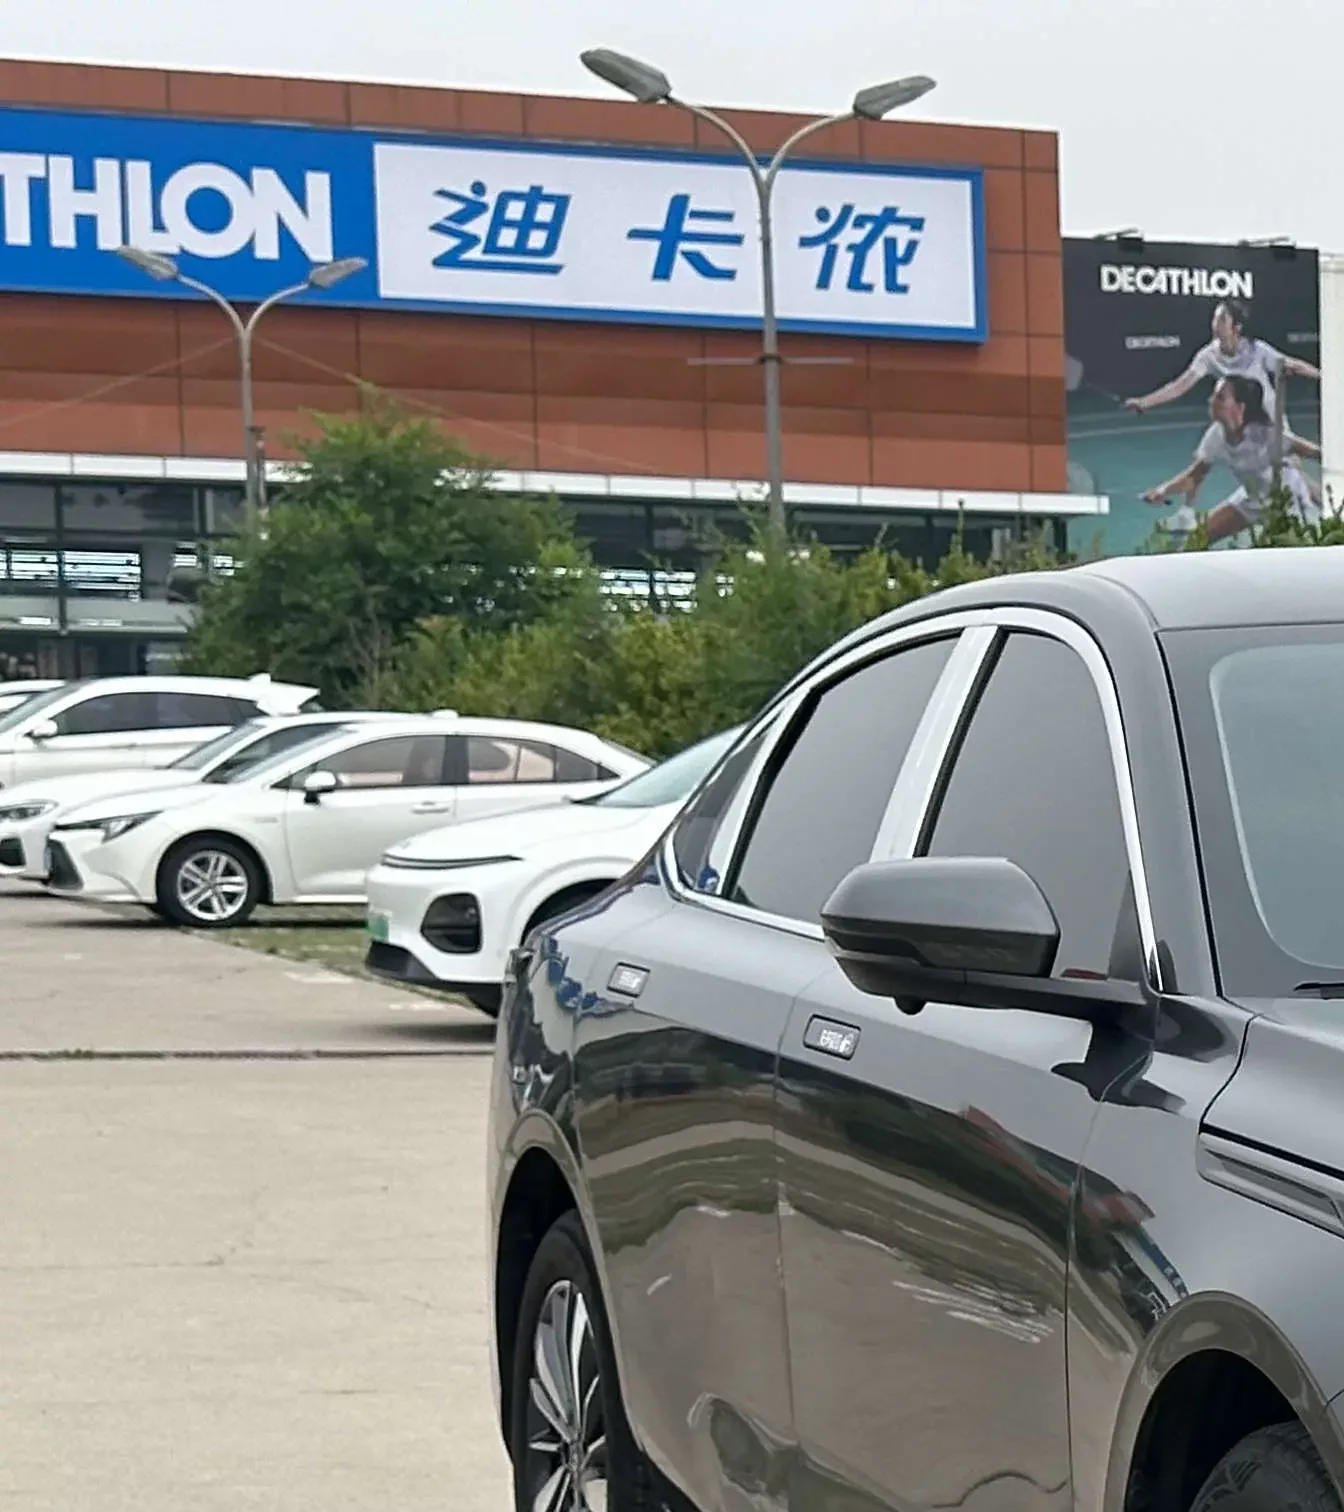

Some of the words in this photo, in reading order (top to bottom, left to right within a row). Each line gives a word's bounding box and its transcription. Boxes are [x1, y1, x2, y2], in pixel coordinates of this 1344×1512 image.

[0, 152, 334, 263] THLON
[429, 180, 926, 294] 迪卡侬
[1101, 265, 1253, 299] DECATHLON
